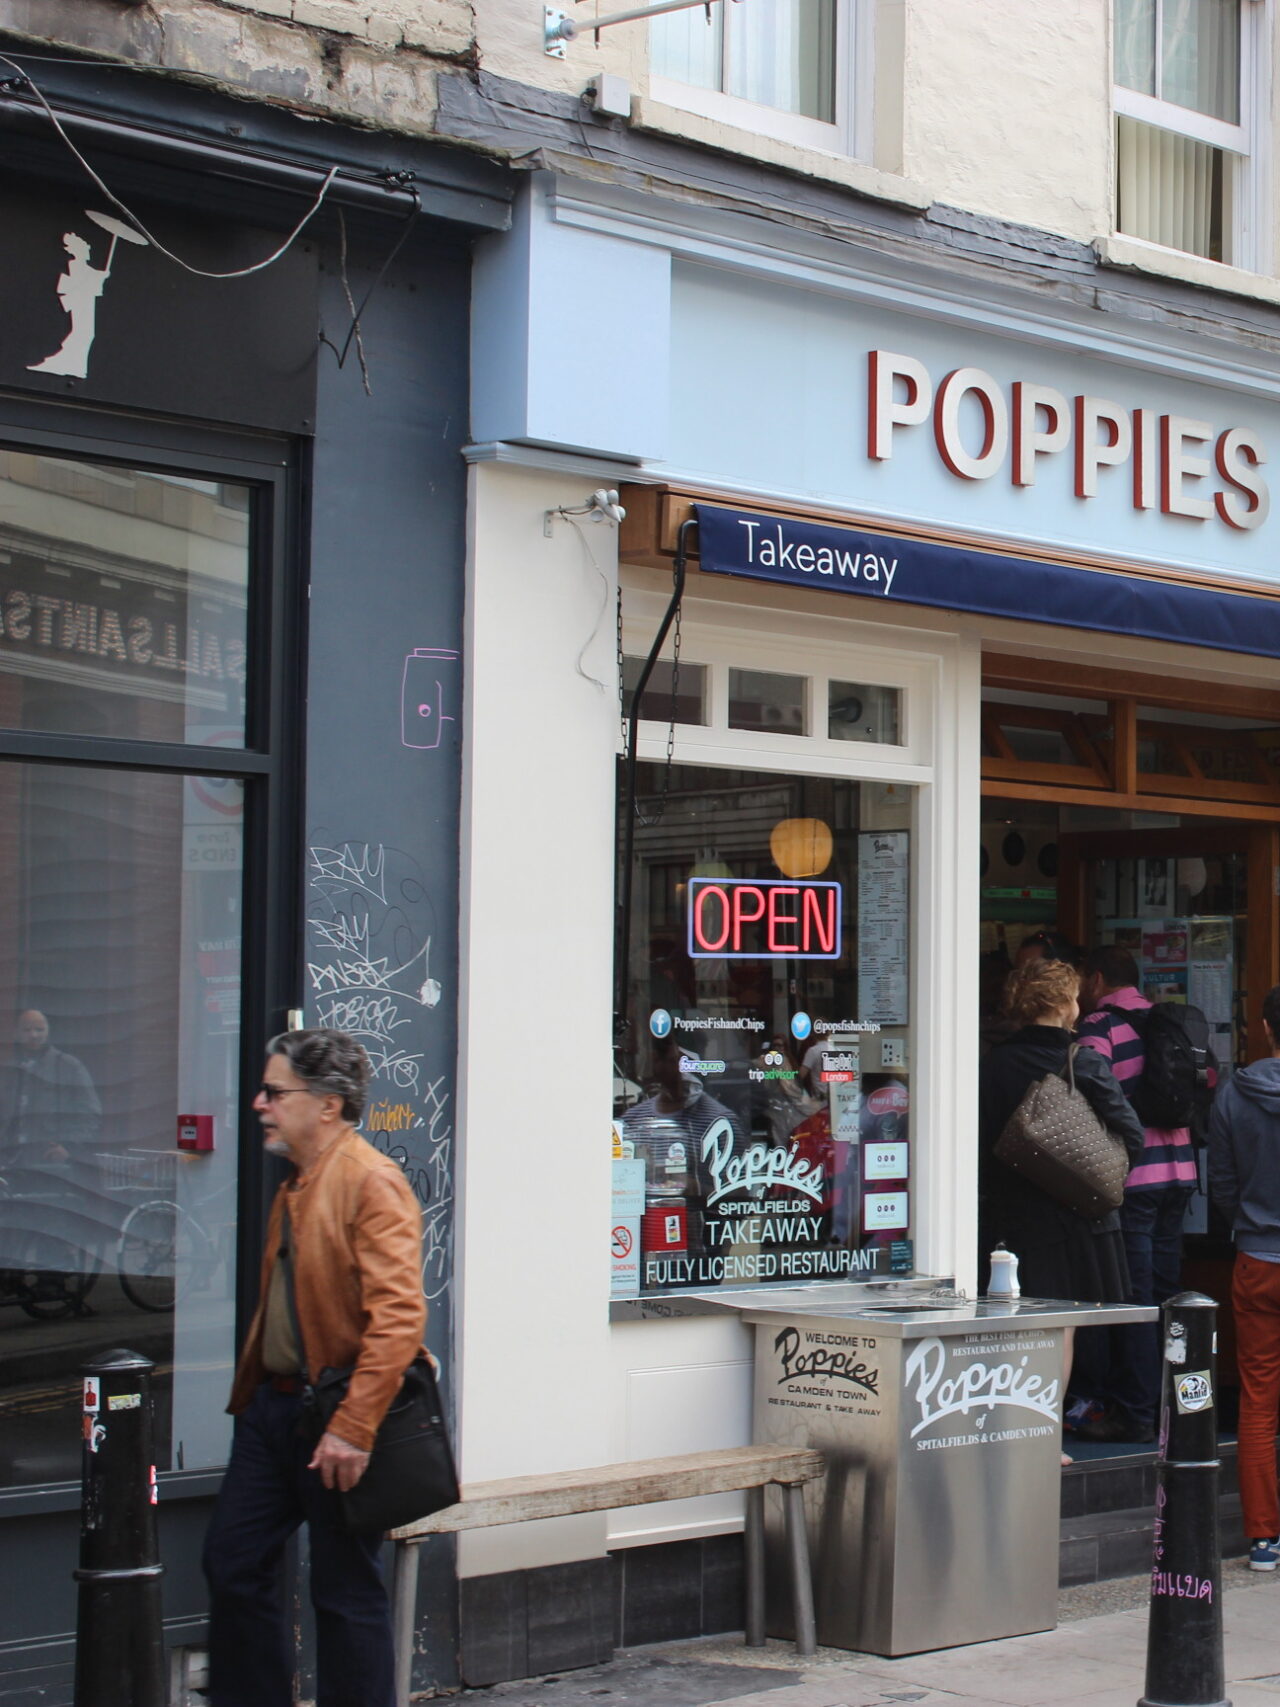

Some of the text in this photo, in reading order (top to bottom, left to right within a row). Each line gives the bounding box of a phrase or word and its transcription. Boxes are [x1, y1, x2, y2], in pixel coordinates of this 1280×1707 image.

[866, 349, 1271, 531] POPPIES
[738, 520, 898, 594] Takeaway
[694, 885, 835, 952] OPEN
[673, 1016, 765, 1032] PoppiesFishandChips
[813, 1019, 881, 1034] @popsfishnchips
[679, 1056, 726, 1076] foursquare
[748, 1068, 796, 1082] tripadvisor
[825, 1073, 849, 1082] London
[701, 1116, 826, 1207] Poppies
[718, 1200, 811, 1215] SPITALFIELDS
[706, 1217, 823, 1246] TAKEAWAY
[646, 1257, 695, 1285] FULLY
[700, 1254, 777, 1281] LICENSED
[781, 1248, 880, 1275] RESTAURANT
[805, 1331, 876, 1348] WELCOME TO
[952, 1338, 1056, 1357] RESTAURANT AND TAKE AWAY
[964, 1334, 980, 1343] THE
[981, 1333, 999, 1343] BEST
[774, 1326, 879, 1396] Poppies
[788, 1384, 867, 1401] CAMDEN TOWN
[904, 1336, 1059, 1438] Poppies
[768, 1397, 822, 1410] RESTAURANT
[834, 1405, 854, 1414] TAKE
[857, 1408, 882, 1417] AWAY
[975, 1413, 987, 1430] of
[916, 1425, 1055, 1451] SPITALFIELDS & CAMDEN TOWN
